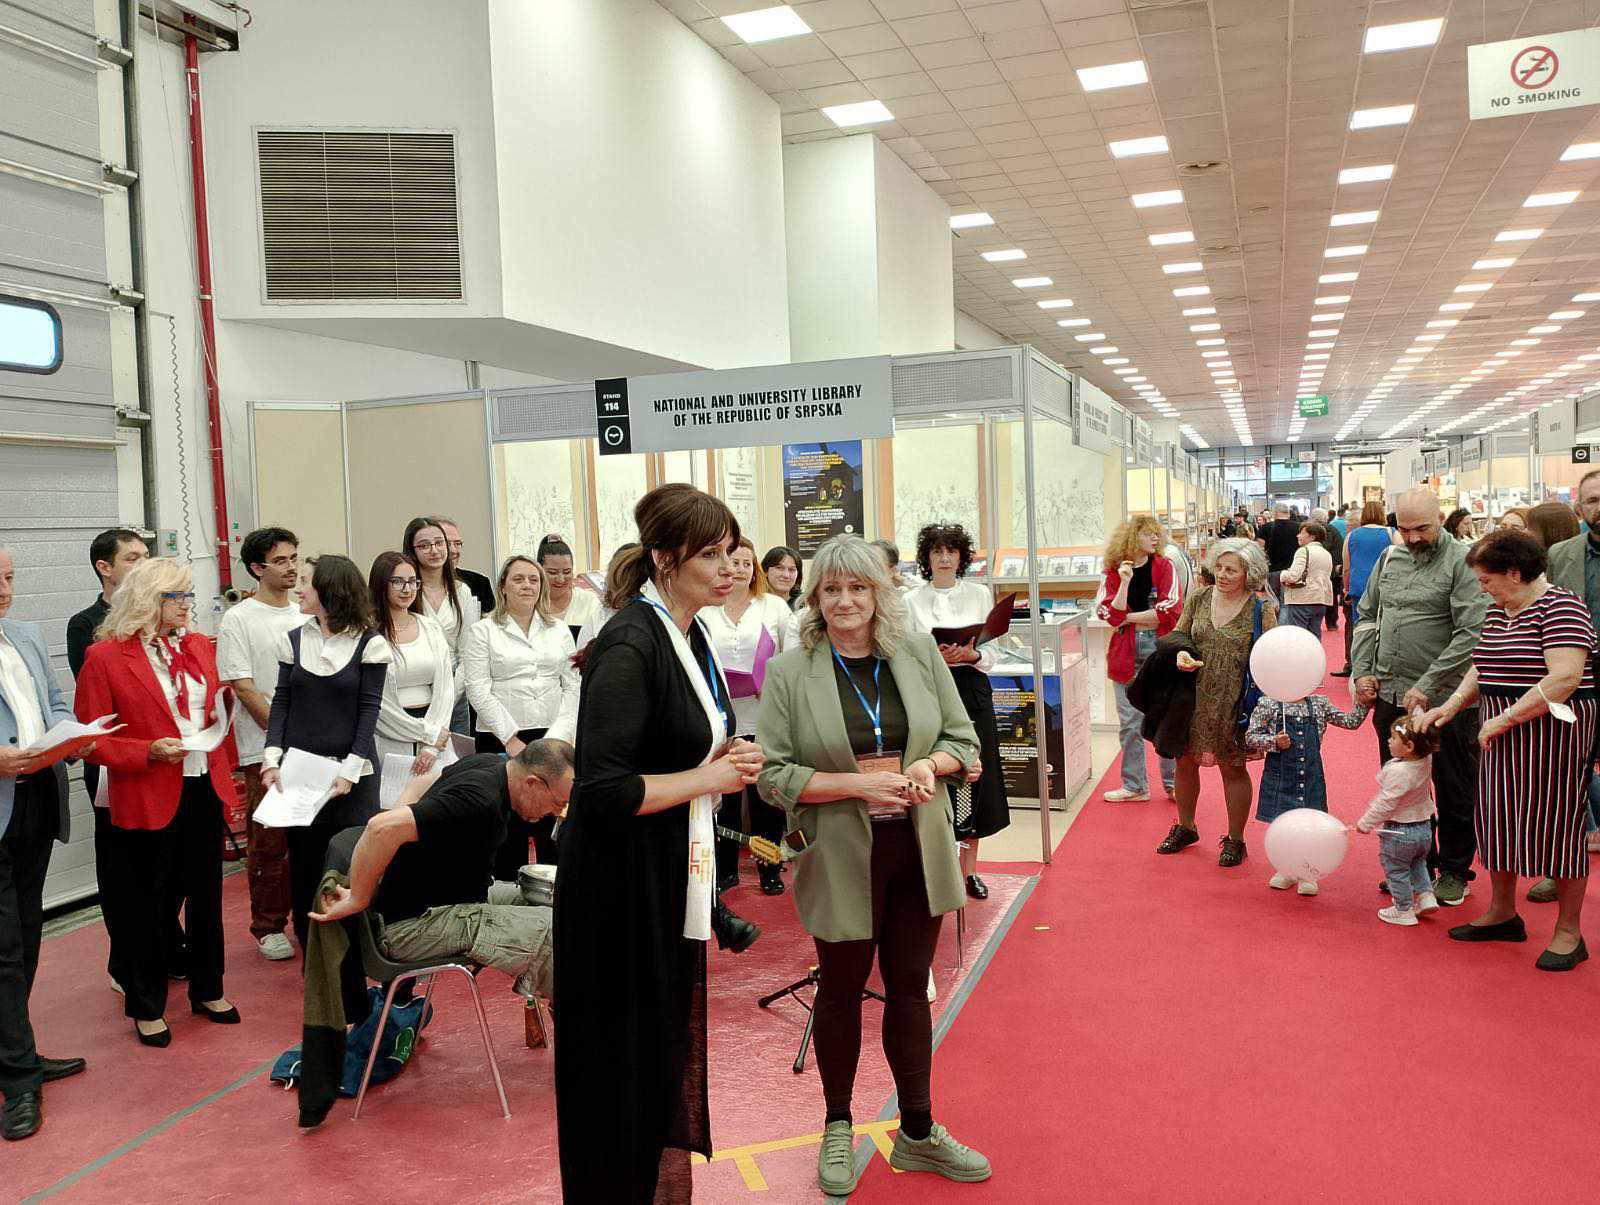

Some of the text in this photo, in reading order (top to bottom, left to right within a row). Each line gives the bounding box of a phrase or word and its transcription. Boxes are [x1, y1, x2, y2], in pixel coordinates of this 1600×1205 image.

[1491, 88, 1581, 108] NO SMOKING
[604, 402, 619, 411] 114
[654, 384, 862, 413] NATIONAL AND UNIVERSITY LIBRARY
[674, 402, 842, 427] OF THE REPUBLIC OF SRPSKA
